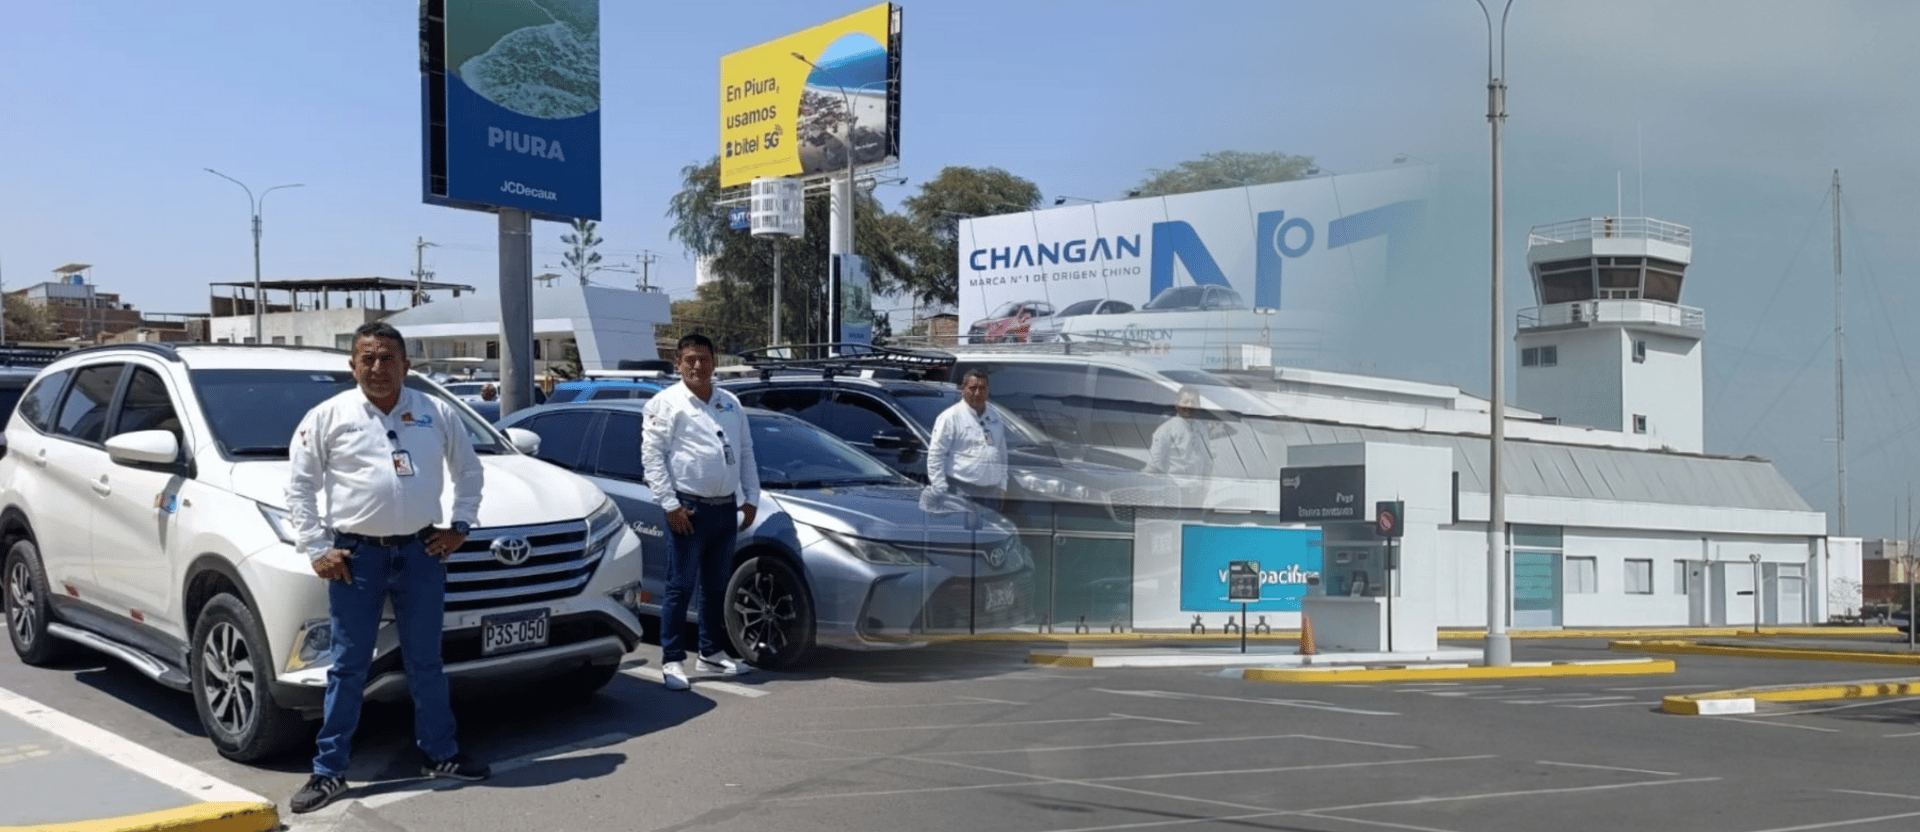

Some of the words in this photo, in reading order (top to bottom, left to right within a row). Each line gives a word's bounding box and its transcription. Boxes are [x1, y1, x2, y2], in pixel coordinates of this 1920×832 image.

[726, 85, 741, 102] En
[744, 77, 780, 98] Piura,
[726, 105, 777, 129] usamos
[488, 126, 565, 162] PIURA
[734, 135, 759, 156] bitel
[764, 131, 780, 150] 5G
[500, 180, 558, 201] JCDecaux
[969, 234, 1141, 271] CHANGAN
[969, 276, 1006, 287] MARCA
[1033, 273, 1048, 282] DE
[1052, 270, 1097, 282] ORIGEN
[1102, 266, 1141, 278] CHINO
[485, 619, 545, 648] P3S-050
